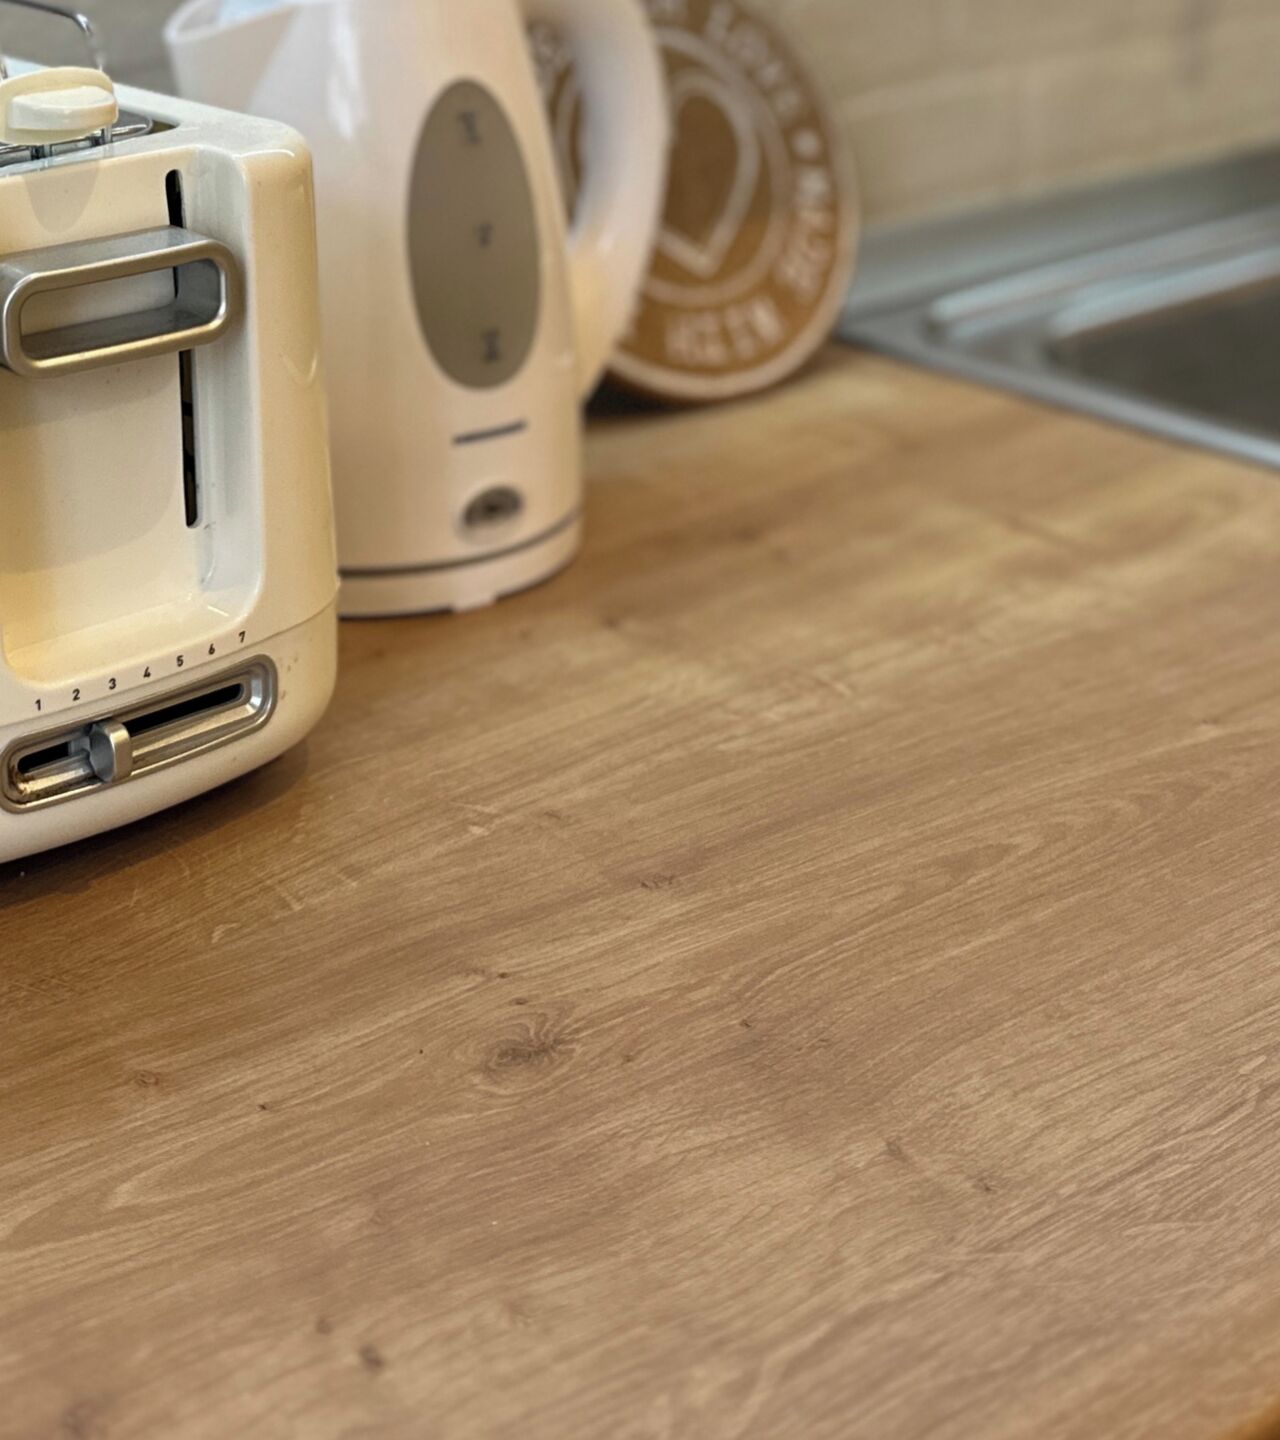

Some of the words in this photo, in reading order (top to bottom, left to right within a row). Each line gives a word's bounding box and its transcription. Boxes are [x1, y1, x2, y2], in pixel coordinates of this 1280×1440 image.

[35, 699, 42, 711] 1
[72, 688, 81, 702] 2
[108, 678, 117, 690] 3
[143, 666, 151, 679] 4
[176, 655, 184, 667] 5
[208, 643, 216, 656] 6
[238, 631, 246, 643] 7
